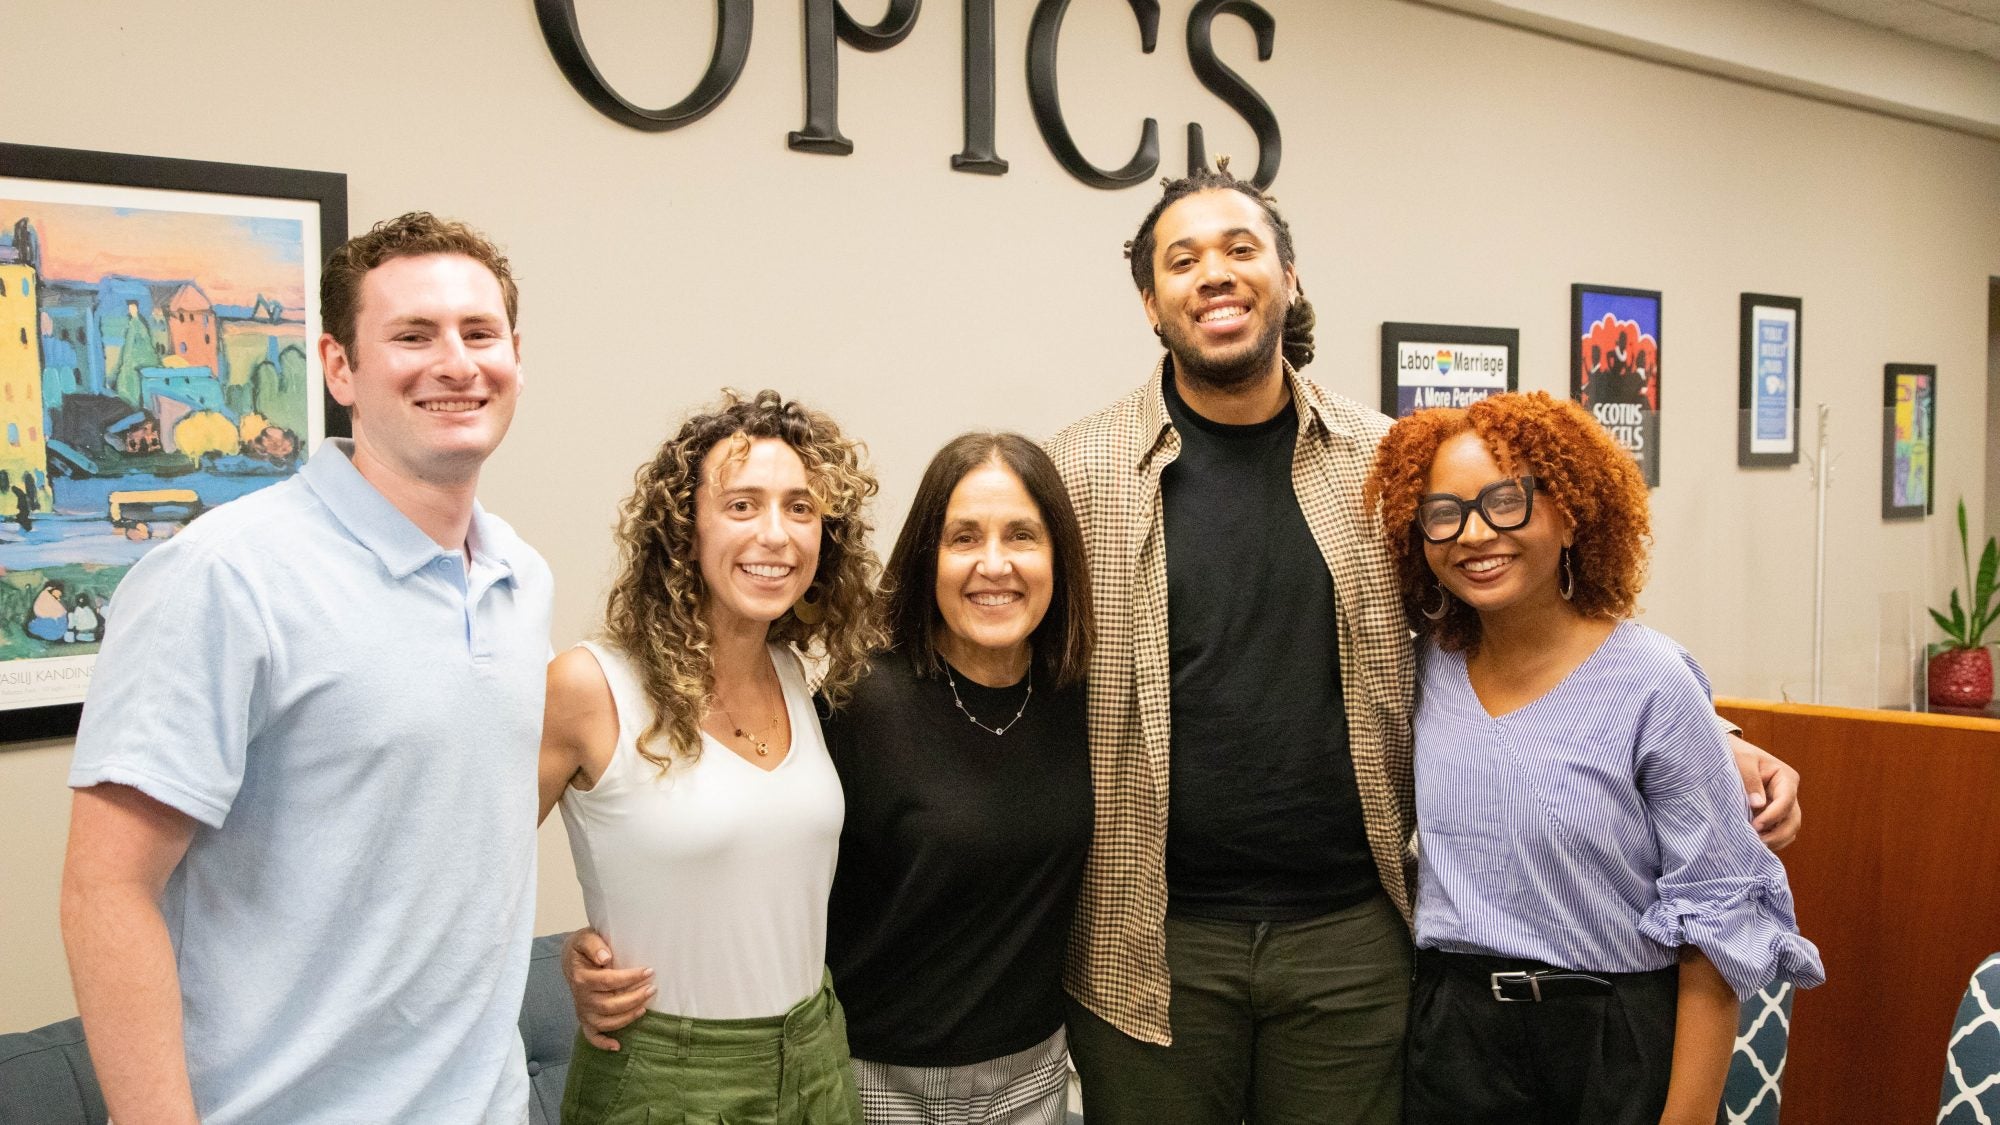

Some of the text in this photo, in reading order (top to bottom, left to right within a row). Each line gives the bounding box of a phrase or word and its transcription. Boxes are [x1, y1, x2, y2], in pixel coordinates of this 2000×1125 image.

[1400, 350, 1504, 376] Labor Marriage
[1414, 386, 1424, 407] A
[1424, 386, 1451, 408] More
[1593, 402, 1643, 425] SCOTUS
